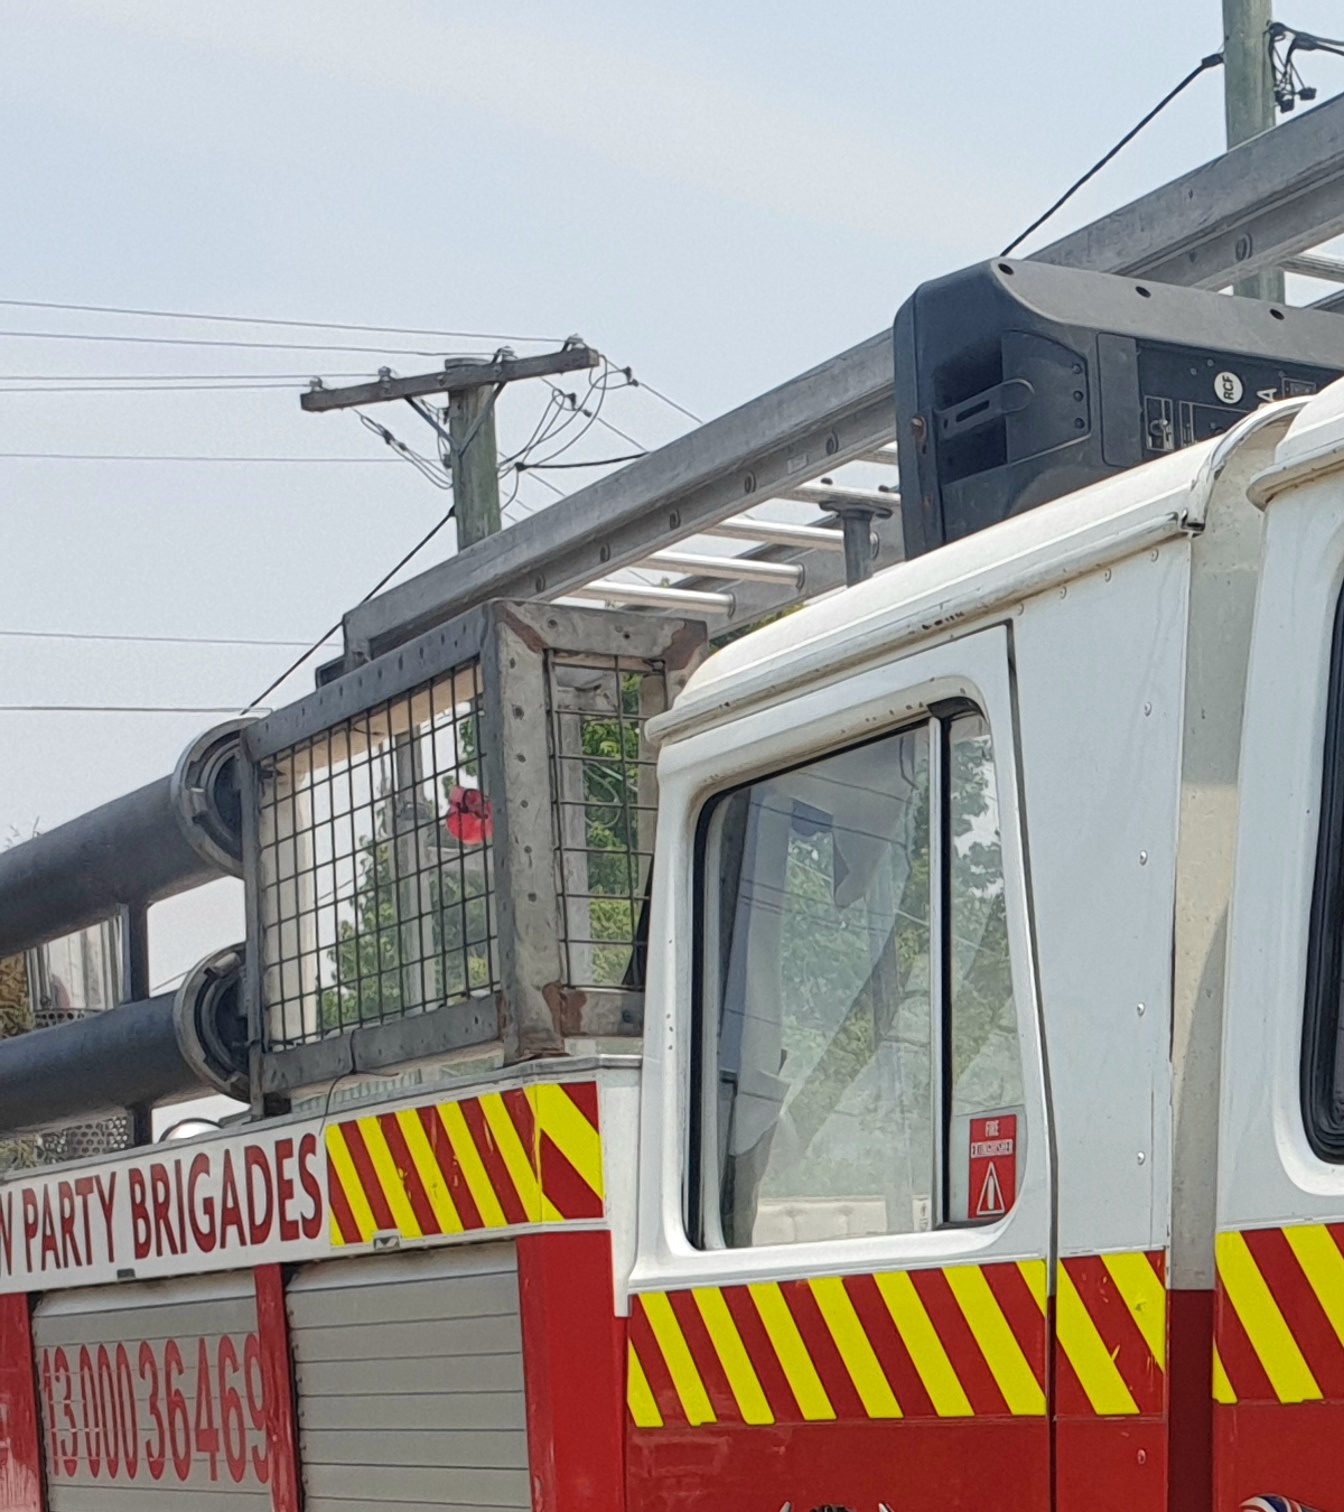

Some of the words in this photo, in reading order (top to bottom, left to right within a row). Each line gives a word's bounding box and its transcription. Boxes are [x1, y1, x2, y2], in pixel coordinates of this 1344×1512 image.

[1222, 375, 1235, 400] RCF
[22, 1172, 117, 1273] PARTY
[128, 1132, 323, 1260] BRIGADES
